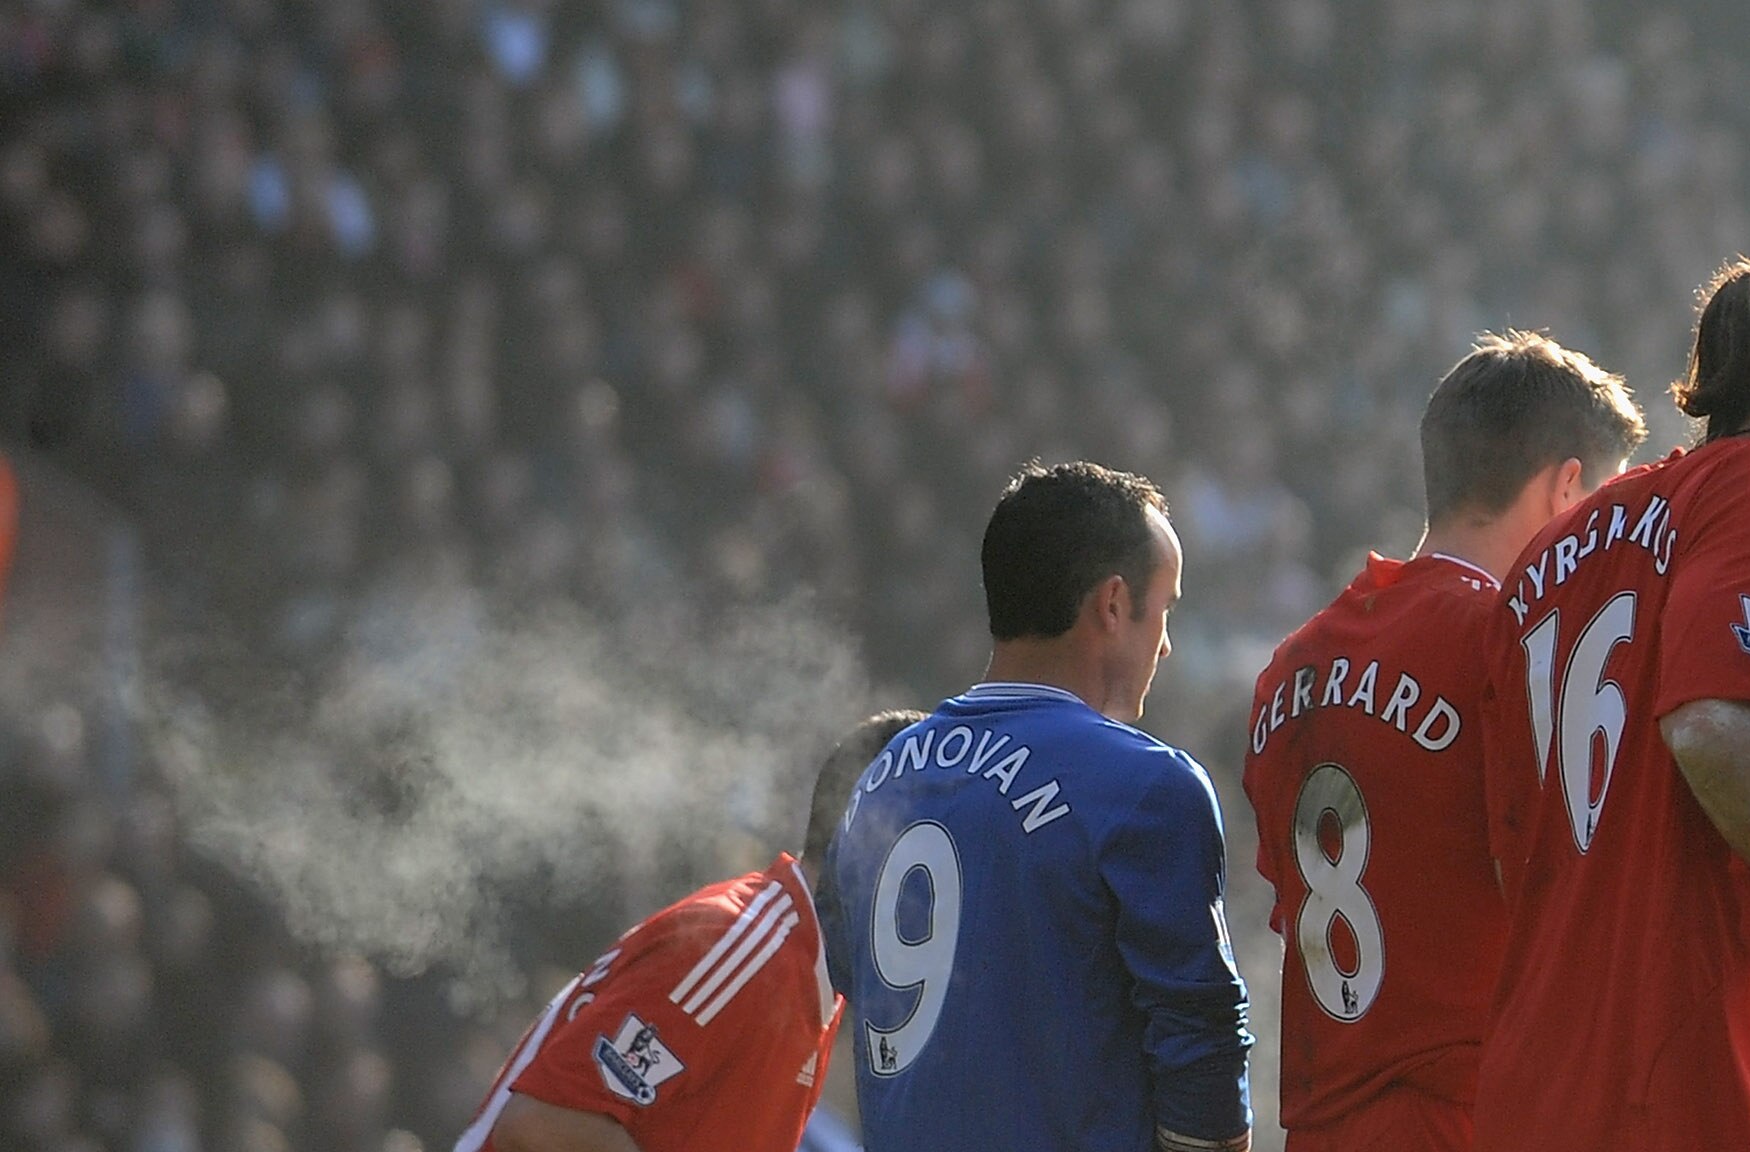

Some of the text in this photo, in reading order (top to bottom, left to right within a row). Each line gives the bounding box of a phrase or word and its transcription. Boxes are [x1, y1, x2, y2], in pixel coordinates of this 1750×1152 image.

[1252, 656, 1463, 755] GERRARD
[1520, 590, 1637, 856] 16
[863, 818, 963, 1079] 9
[1291, 761, 1386, 1024] 8
